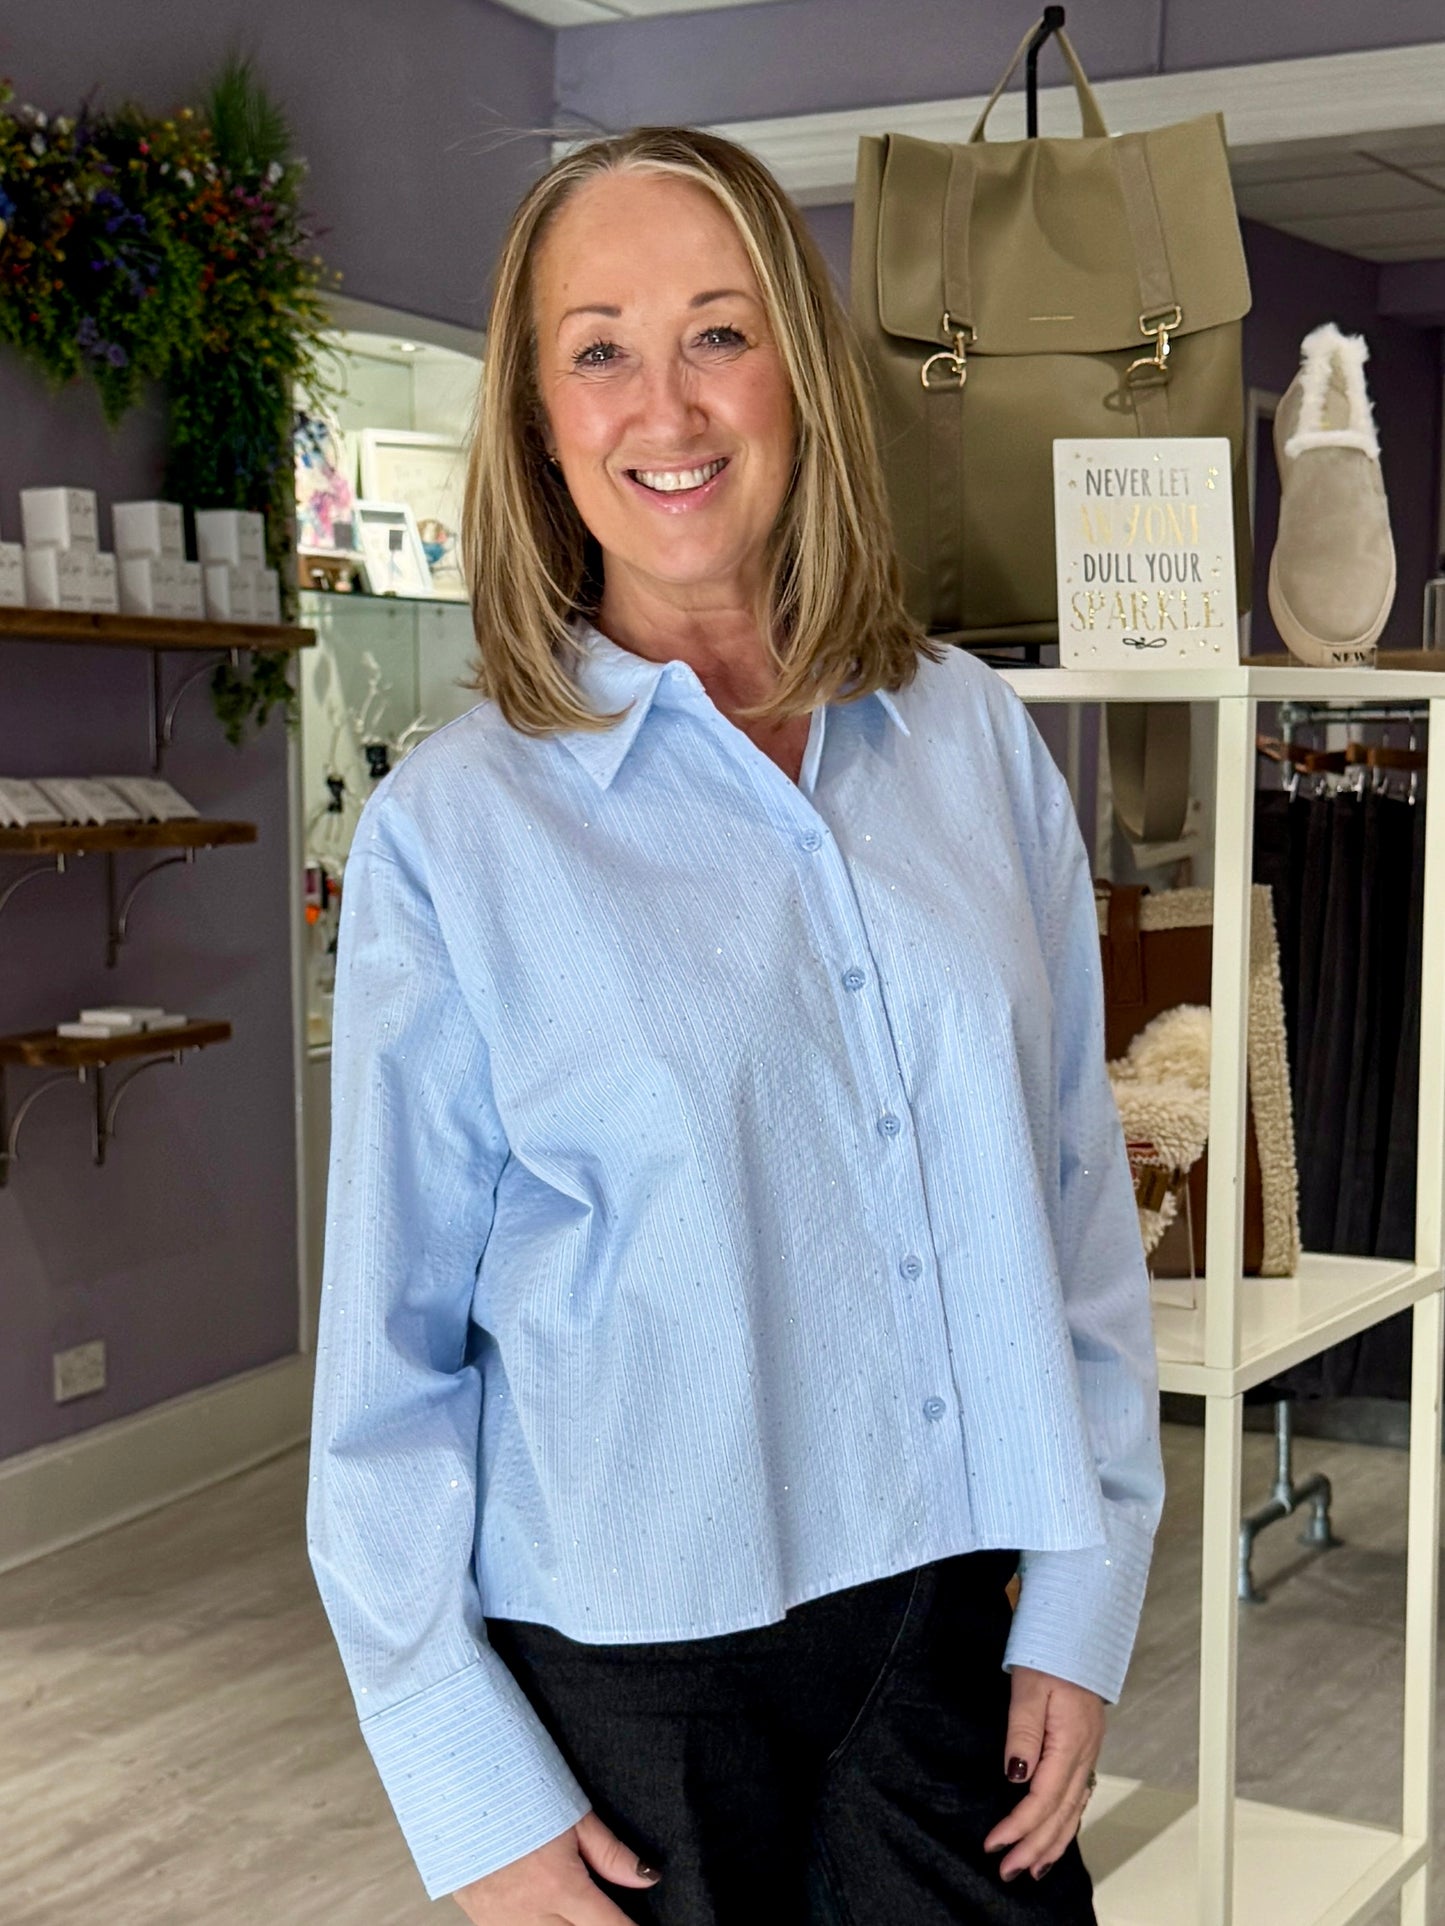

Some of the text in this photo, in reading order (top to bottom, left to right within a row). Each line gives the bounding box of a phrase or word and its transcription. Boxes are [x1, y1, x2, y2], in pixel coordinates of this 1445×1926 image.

[1086, 468, 1190, 497] NEVER LET
[1084, 552, 1202, 583] DULL YOUR
[1070, 589, 1224, 632] SPARKLE
